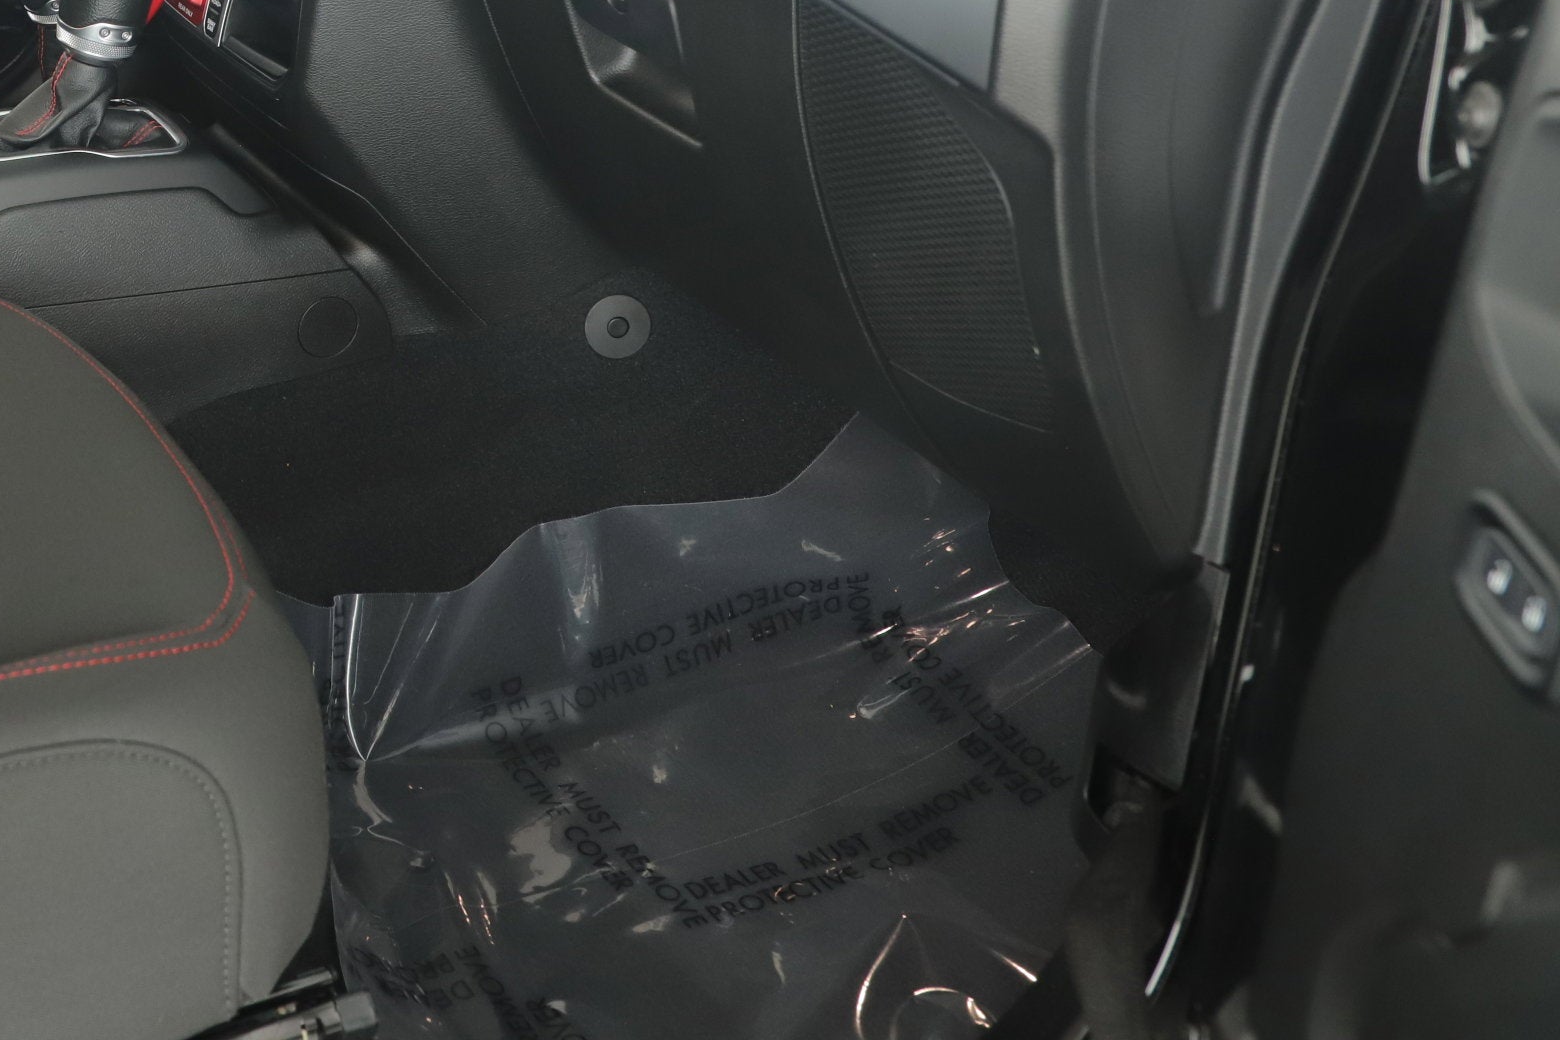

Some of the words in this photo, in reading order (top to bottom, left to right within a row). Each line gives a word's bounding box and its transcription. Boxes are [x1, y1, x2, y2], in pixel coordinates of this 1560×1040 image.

[686, 576, 840, 636] PROTECTIVE
[749, 596, 840, 642] DEALER
[587, 623, 675, 669] COVER
[663, 630, 733, 678] MUST
[540, 664, 648, 724] REMOVE
[938, 666, 1073, 789] PROTECTIVE
[471, 687, 570, 820] PROTECTIVE
[564, 825, 633, 893] COVER
[500, 676, 561, 772] DEALER
[559, 781, 622, 835] MUST
[958, 731, 1045, 806] DEALER
[684, 861, 787, 901] DEALER
[793, 832, 871, 871] MUST
[877, 773, 993, 839] REMOVE
[706, 865, 865, 923] PROTECTIVE
[868, 826, 961, 872] COVER
